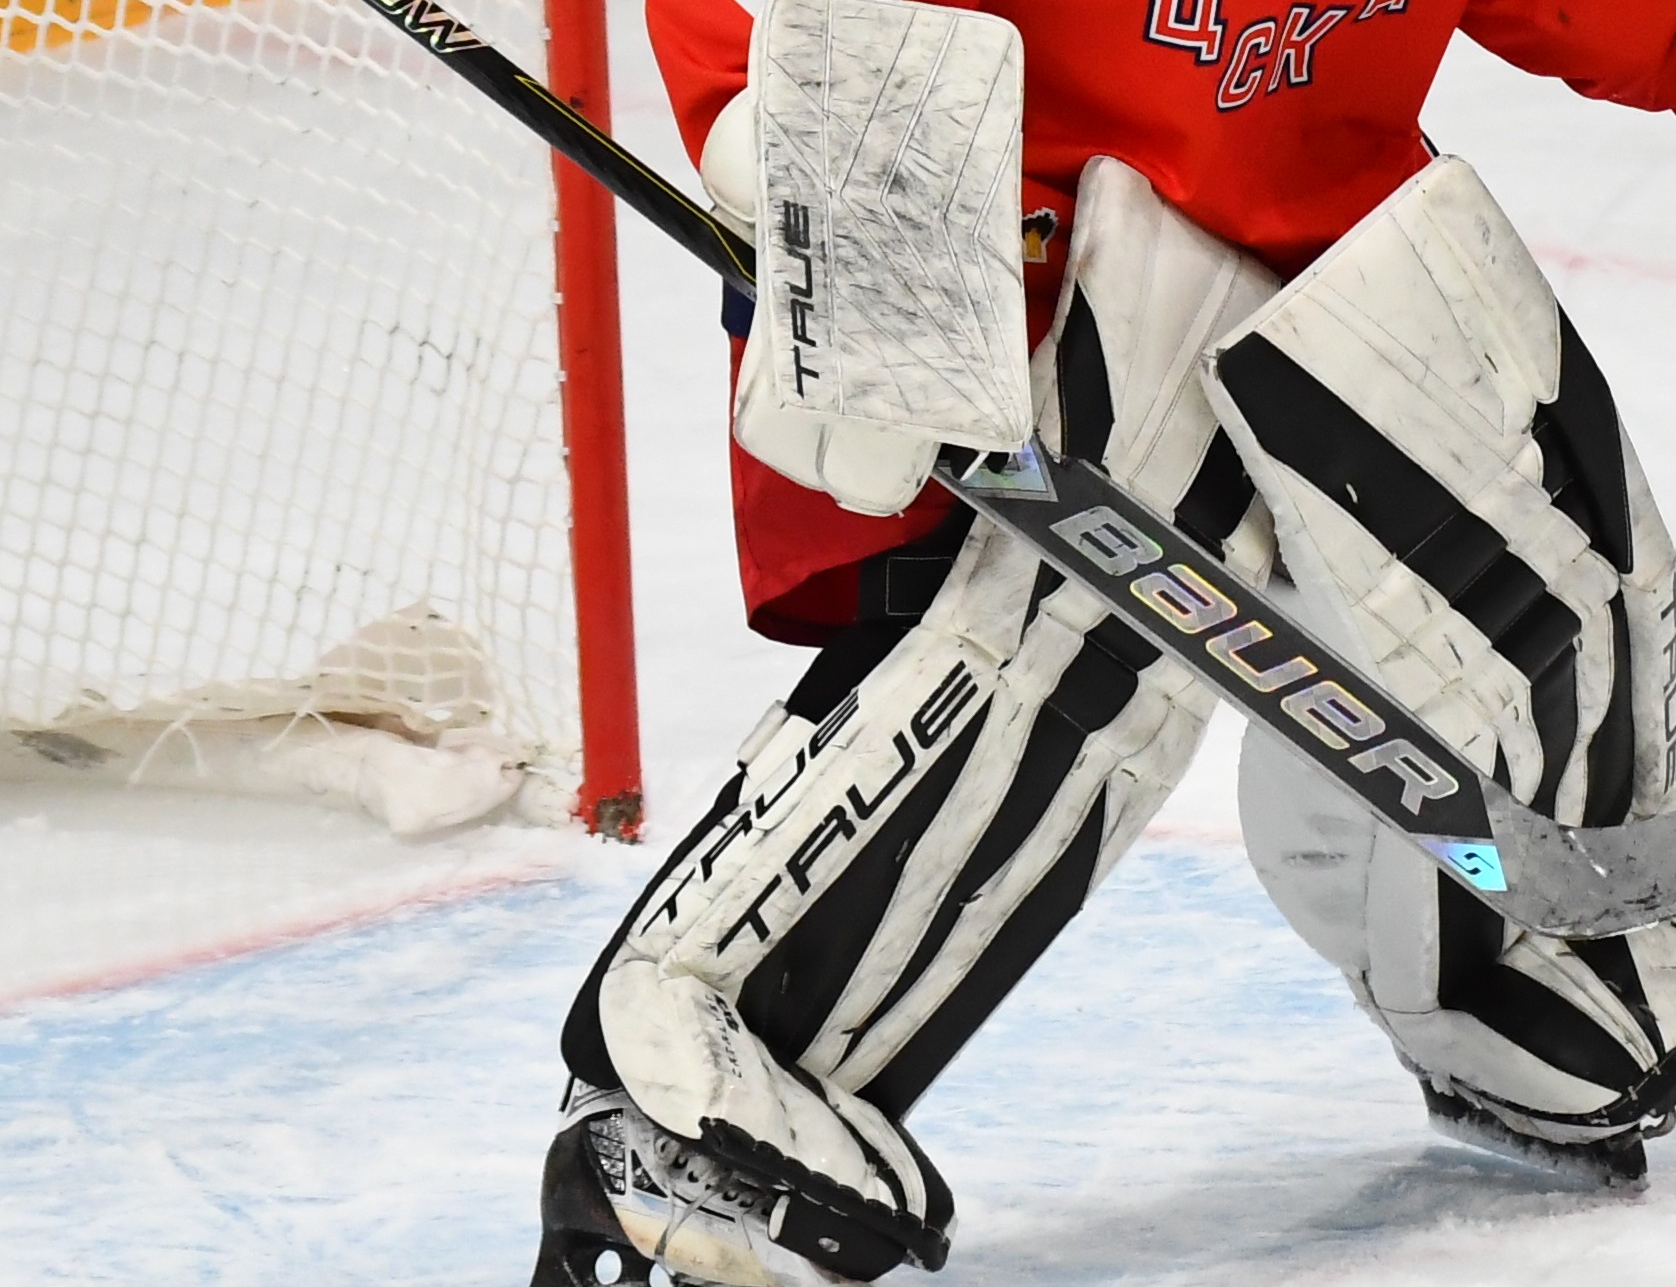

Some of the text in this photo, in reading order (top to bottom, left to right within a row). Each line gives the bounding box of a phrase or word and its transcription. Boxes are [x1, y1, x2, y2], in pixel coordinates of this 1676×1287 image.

[782, 199, 822, 401] TRUE
[1049, 505, 1460, 816] BAUER
[639, 687, 861, 938] TRUE
[716, 659, 980, 958] TRUE
